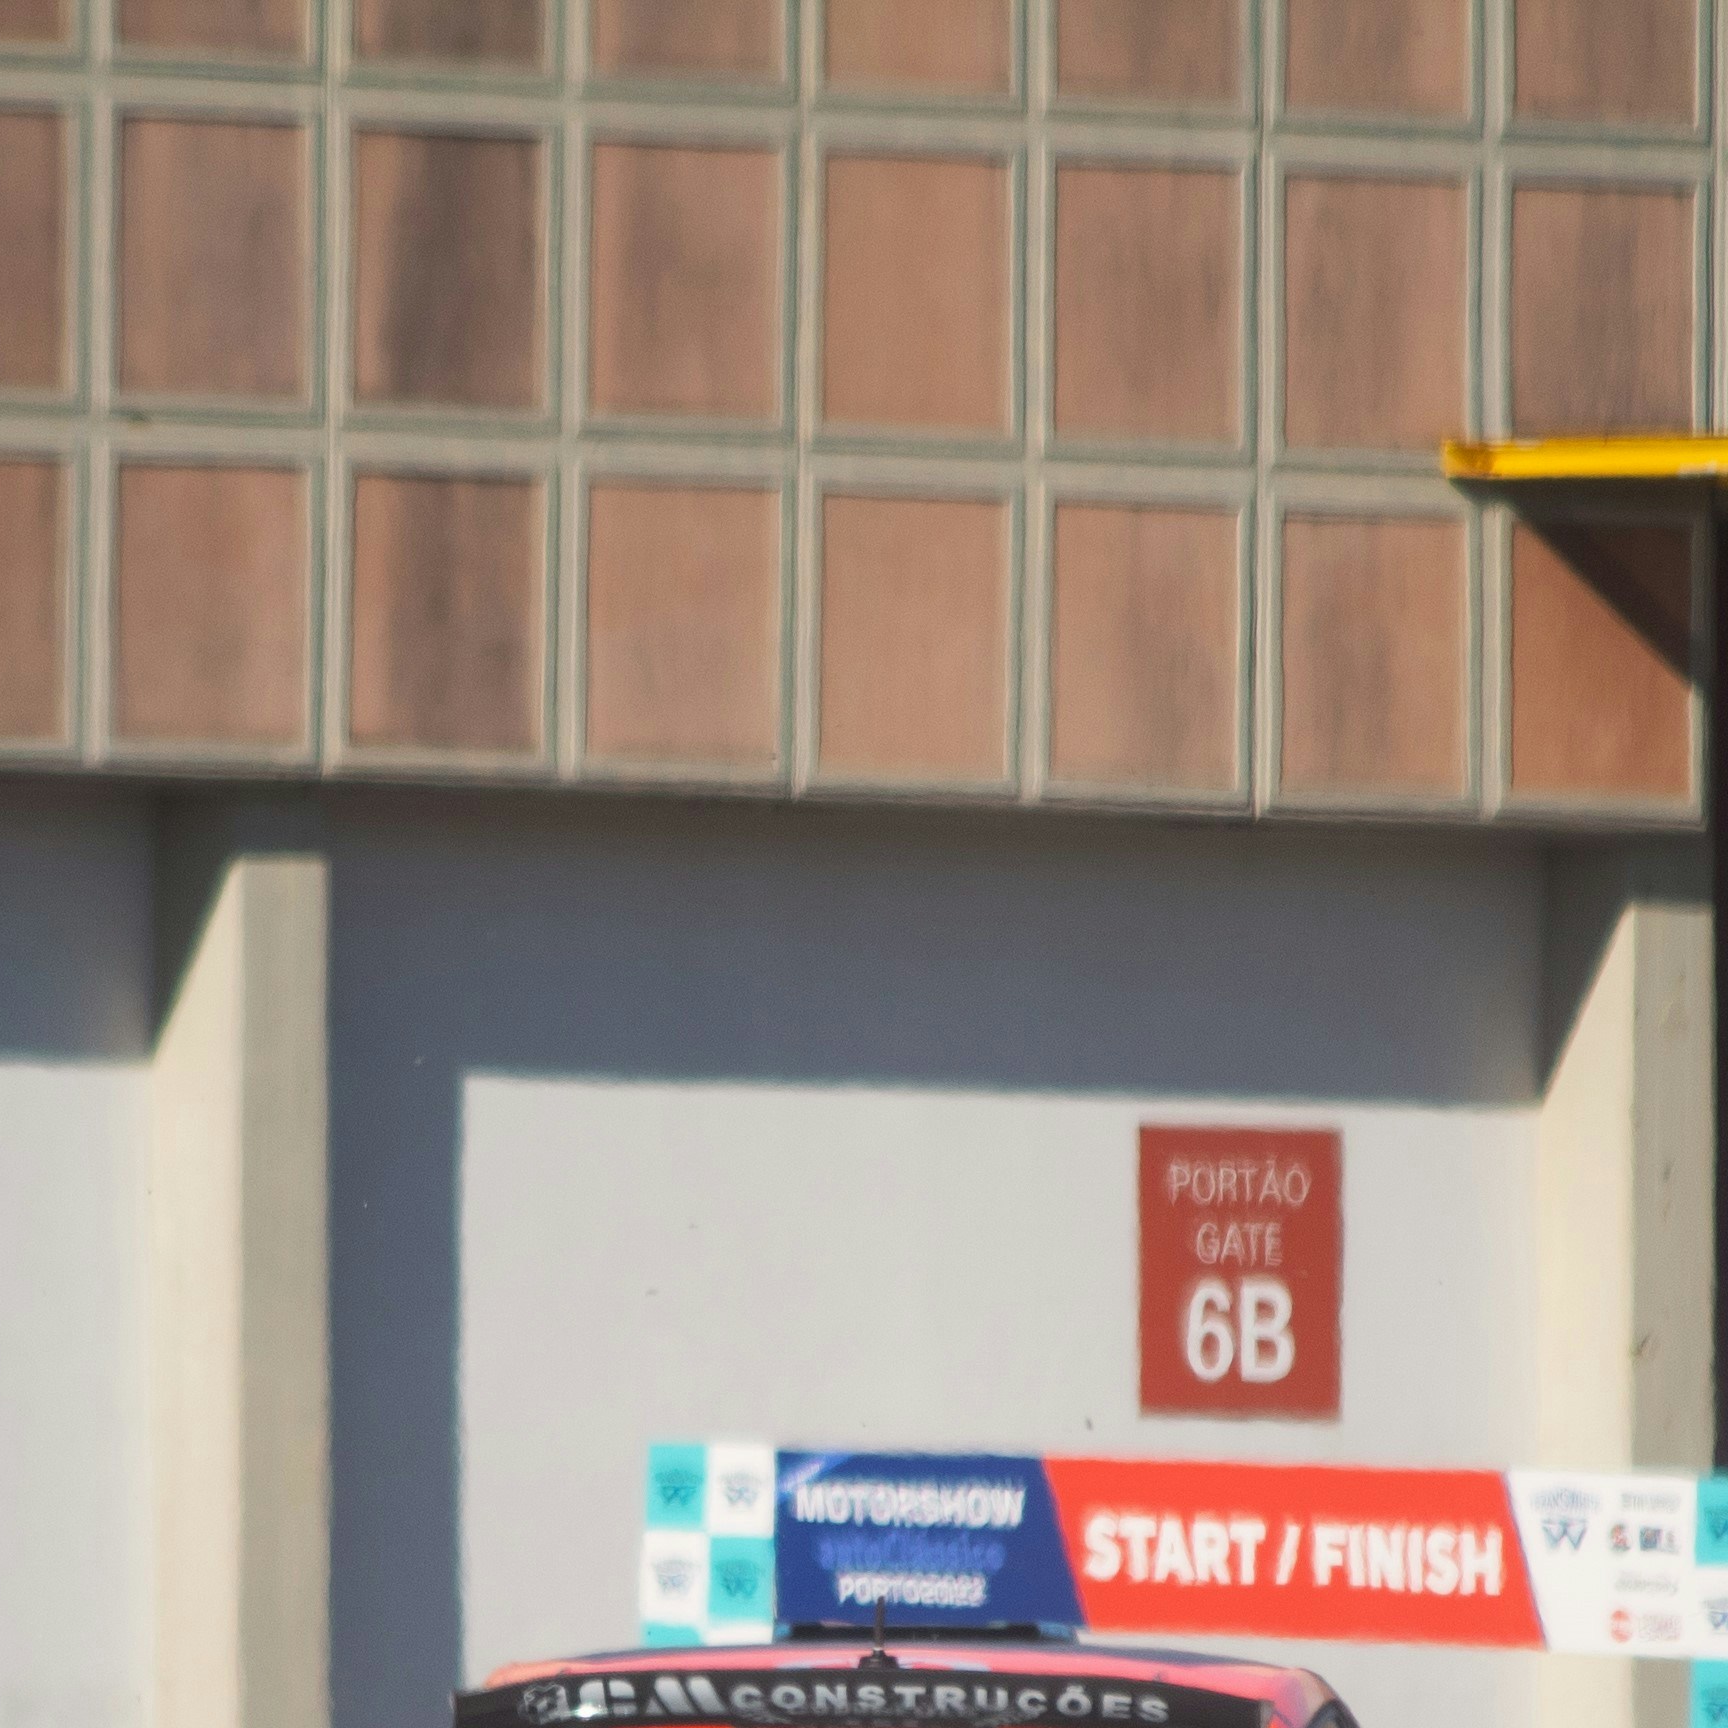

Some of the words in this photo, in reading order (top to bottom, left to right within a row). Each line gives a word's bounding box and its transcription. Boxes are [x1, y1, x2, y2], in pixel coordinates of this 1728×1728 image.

[1168, 1156, 1313, 1206] PORTÃO
[1194, 1220, 1284, 1266] GATE
[1186, 1278, 1296, 1384] 6B
[794, 1478, 1027, 1529] MOTORSHOW
[1084, 1513, 1267, 1587] START
[1312, 1523, 1503, 1597] FINISH
[731, 1684, 1170, 1722] CONSTRUÇÕES
